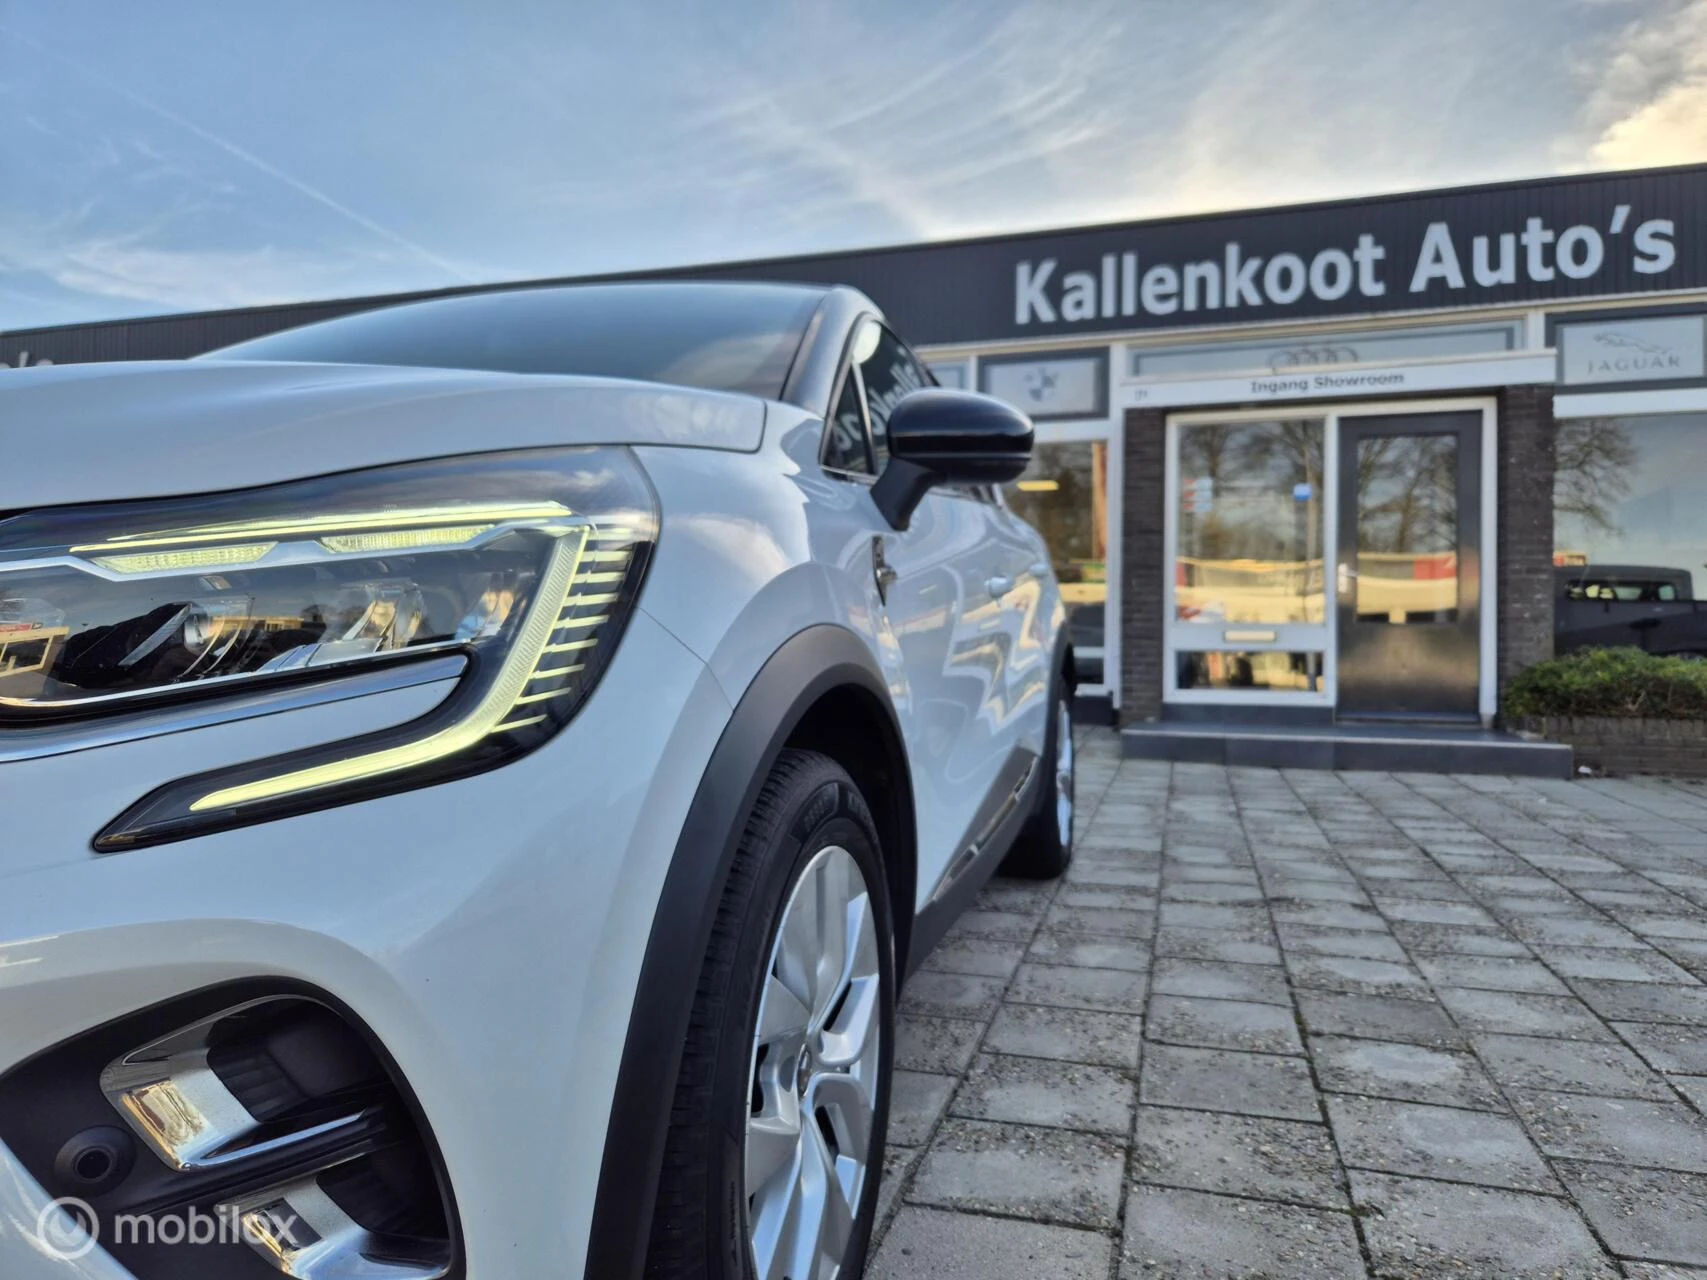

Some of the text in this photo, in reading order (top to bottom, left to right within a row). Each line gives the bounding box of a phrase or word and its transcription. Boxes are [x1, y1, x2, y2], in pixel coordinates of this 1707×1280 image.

[1014, 204, 1676, 325] Kallenkoot Auto's
[1587, 354, 1680, 375] JAGUAR
[1251, 373, 1405, 395] Ingang Showroom
